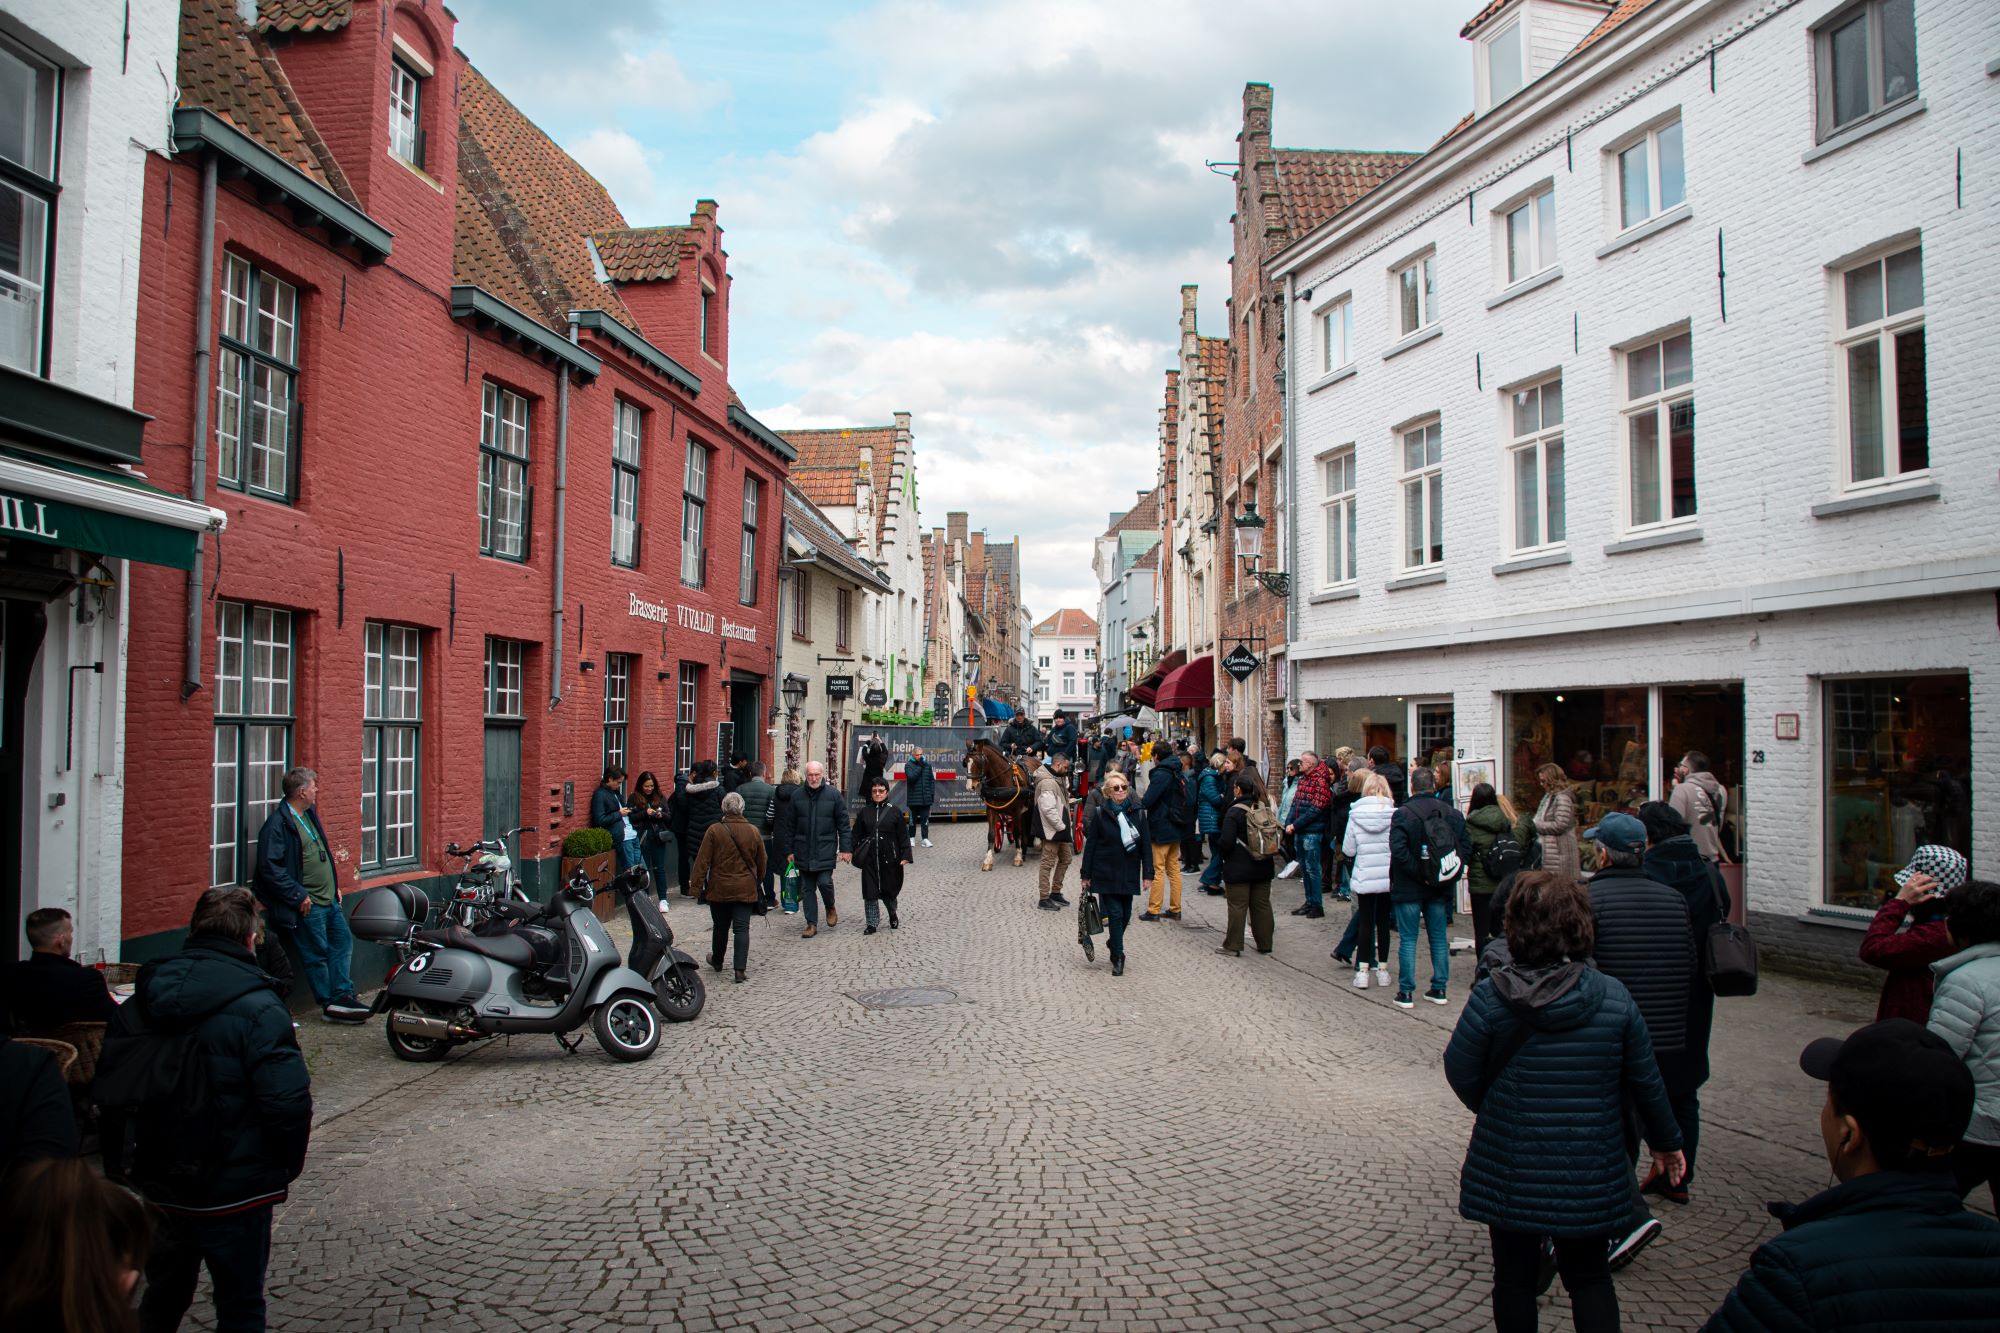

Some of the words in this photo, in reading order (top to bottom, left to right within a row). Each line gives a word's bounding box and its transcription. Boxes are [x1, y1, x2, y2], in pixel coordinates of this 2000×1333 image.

[629, 592, 668, 623] Brasserie
[677, 604, 715, 635] VIVALDI
[721, 617, 757, 642] Restaurant
[1226, 655, 1255, 666] Chocolate
[1457, 748, 1465, 759] 27
[1752, 750, 1765, 763] 29
